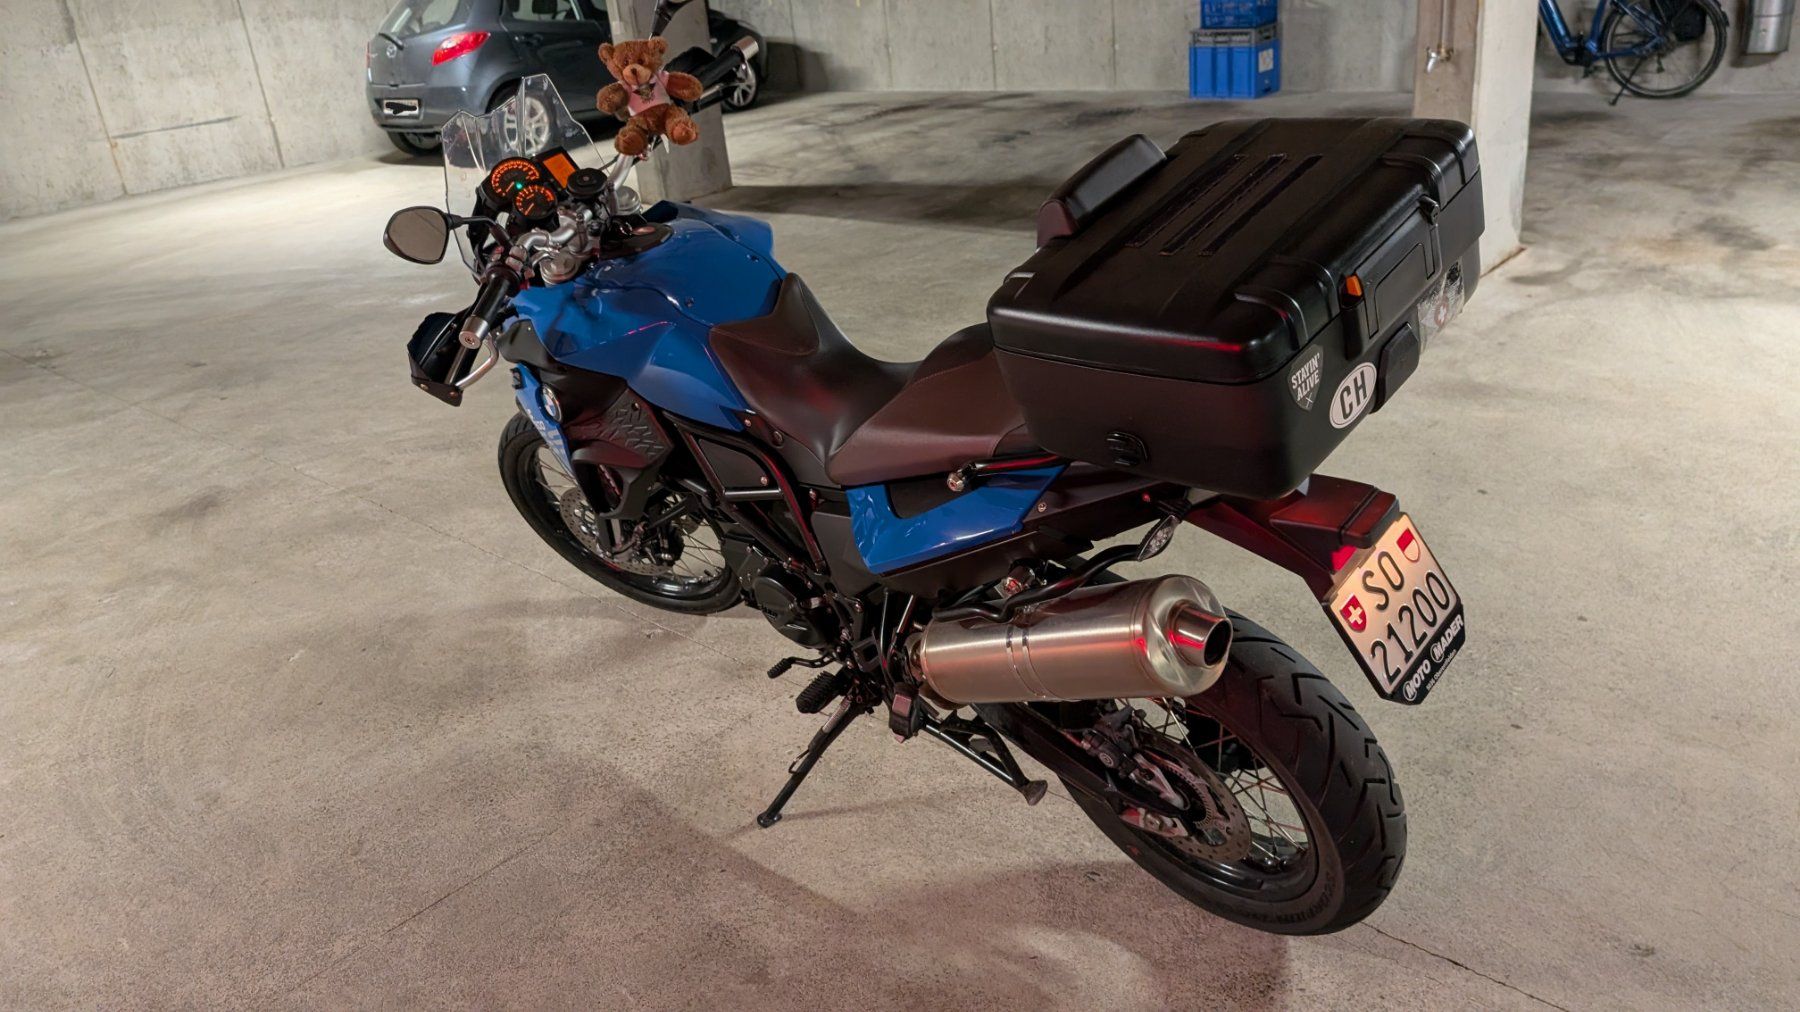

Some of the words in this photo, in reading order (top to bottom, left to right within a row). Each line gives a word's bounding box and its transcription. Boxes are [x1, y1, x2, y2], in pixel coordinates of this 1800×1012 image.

[1291, 353, 1320, 389] STAYIN'
[1297, 370, 1320, 402] ALIVE
[1340, 370, 1368, 420] CH
[1362, 551, 1404, 611] SO
[1371, 571, 1450, 685] 21200
[1404, 659, 1431, 700] MOTO
[1431, 614, 1464, 661] MADER
